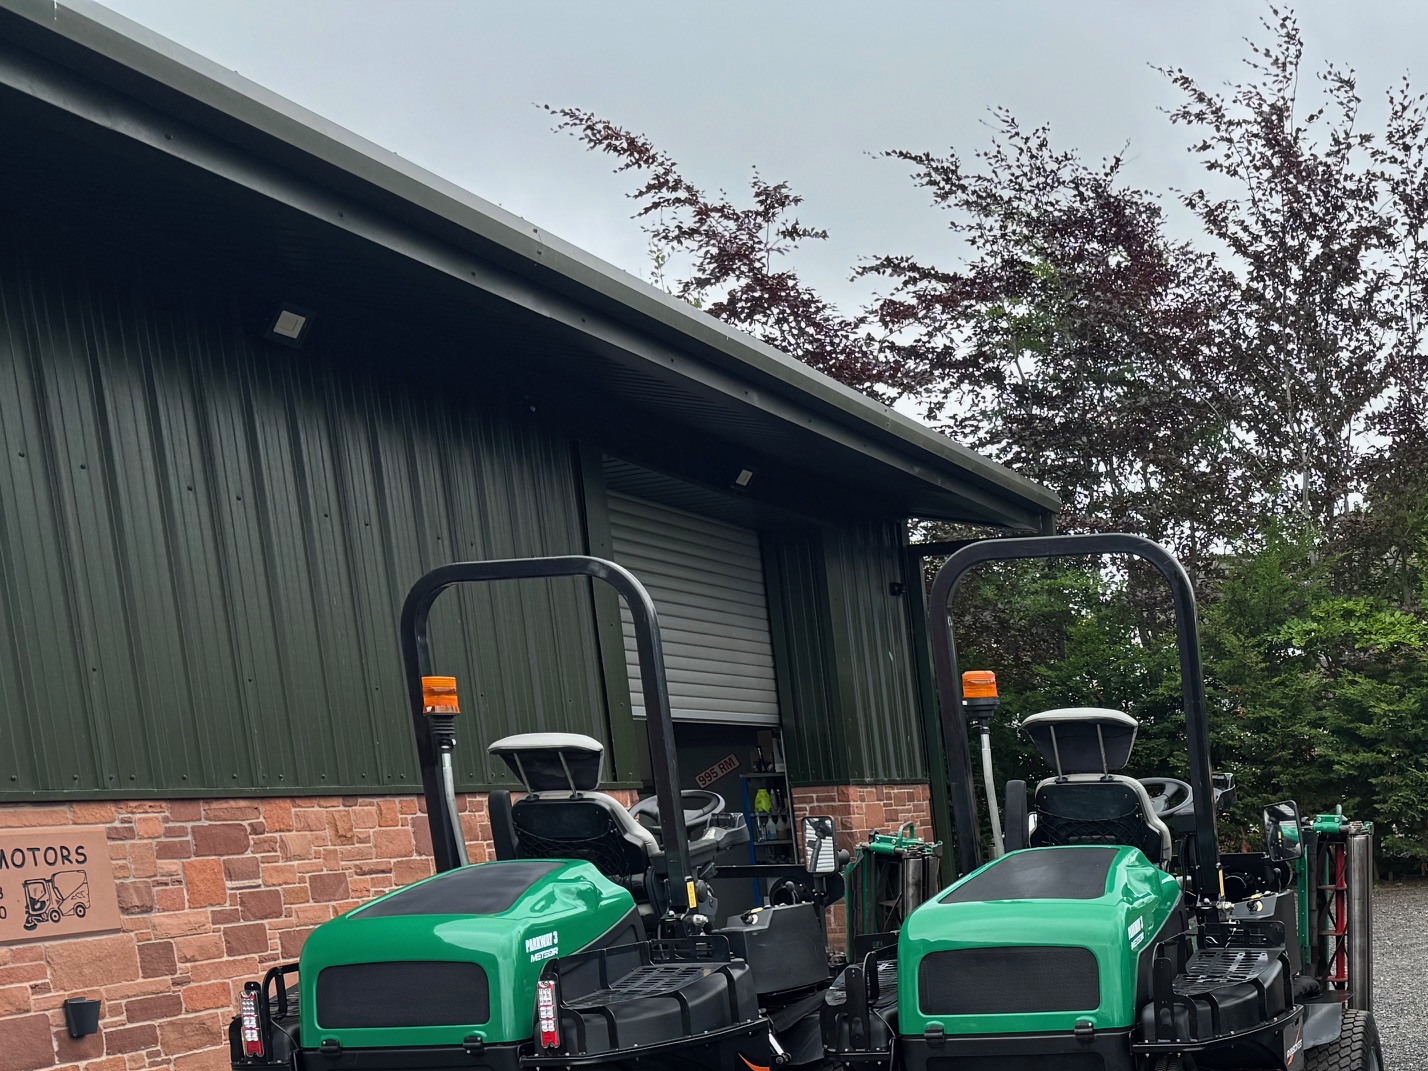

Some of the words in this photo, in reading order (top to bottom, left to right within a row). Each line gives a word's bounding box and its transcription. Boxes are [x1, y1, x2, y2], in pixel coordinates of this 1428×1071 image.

[698, 768, 719, 786] 995
[717, 756, 736, 774] RM
[552, 930, 559, 945] 3
[530, 946, 559, 963] METEOR
